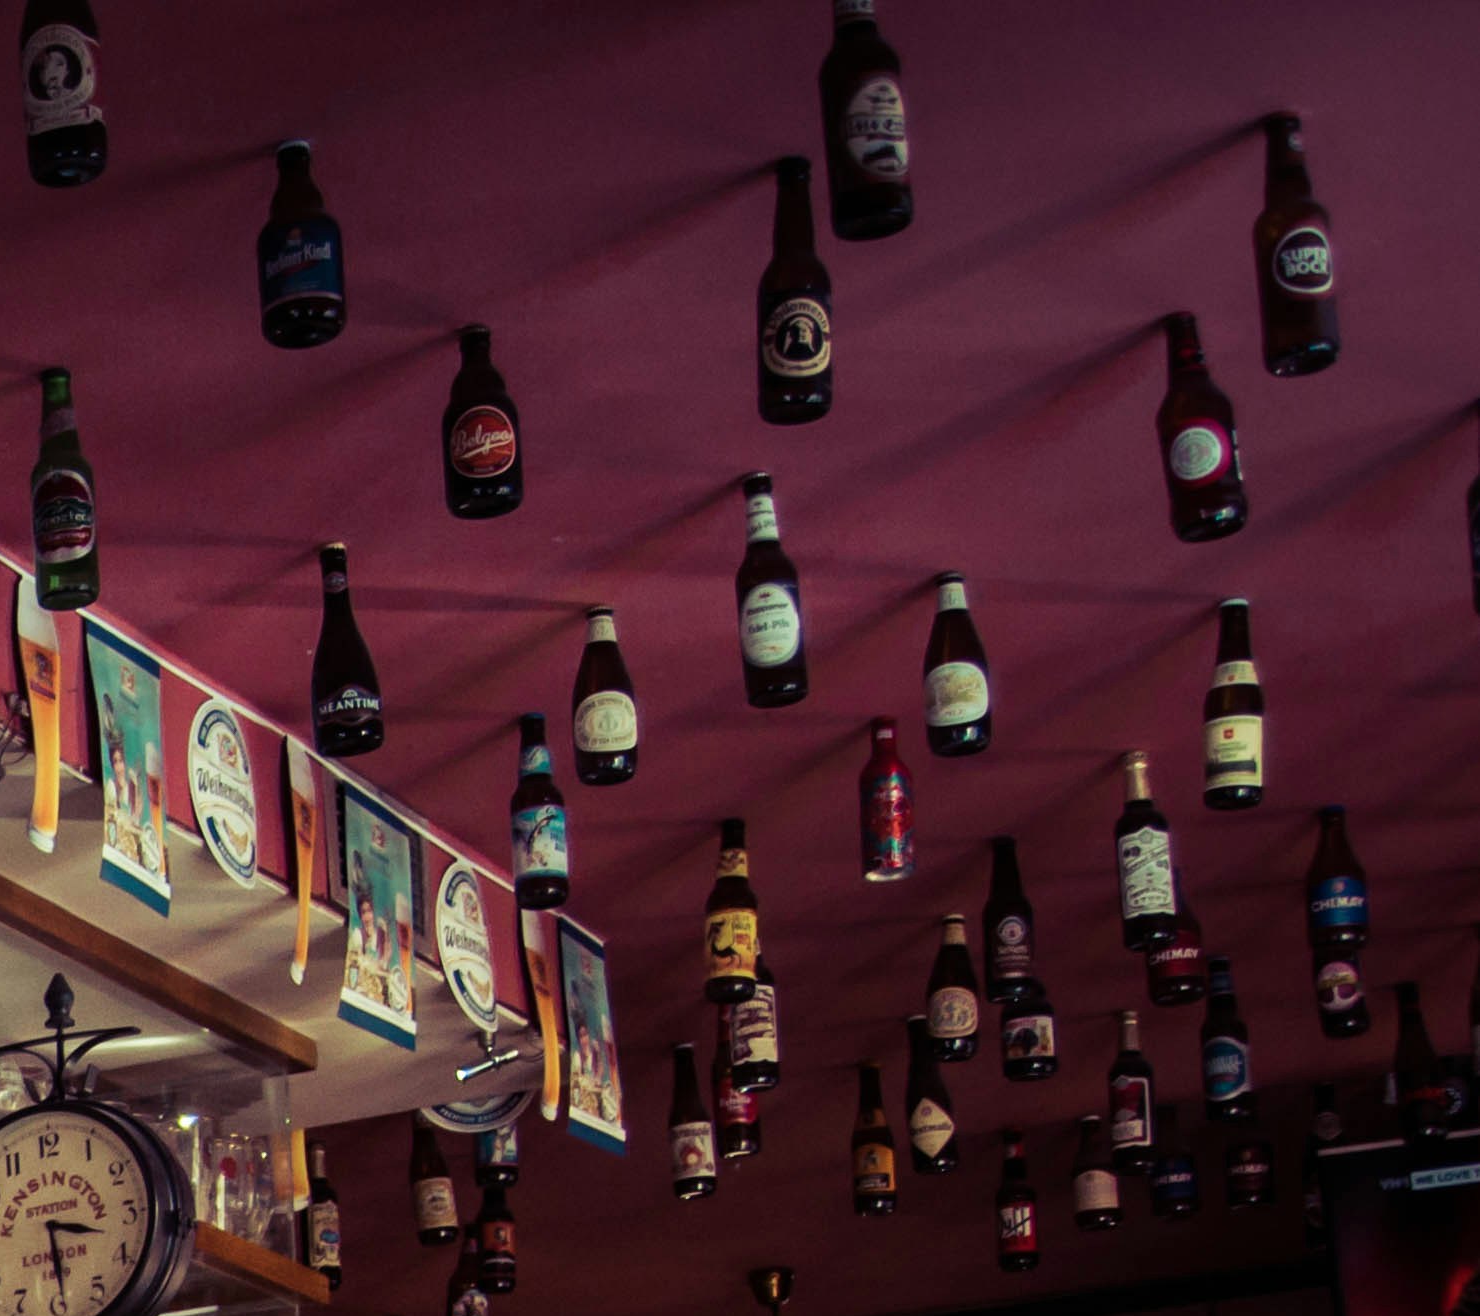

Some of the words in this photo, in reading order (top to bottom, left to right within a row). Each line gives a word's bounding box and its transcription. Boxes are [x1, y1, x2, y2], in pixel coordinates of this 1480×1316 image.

[1284, 261, 1328, 279] BOCK
[38, 1131, 61, 1160] 12
[85, 1138, 92, 1162] 1
[5, 1152, 21, 1178] 11
[109, 1161, 125, 1187] 2
[0, 1170, 108, 1239] KENSINGTON
[25, 1197, 79, 1220] STATION
[122, 1199, 138, 1226] 3
[21, 1243, 88, 1268] LONDON
[111, 1241, 129, 1267] 4
[14, 1288, 28, 1314] 7
[90, 1275, 107, 1303] 5
